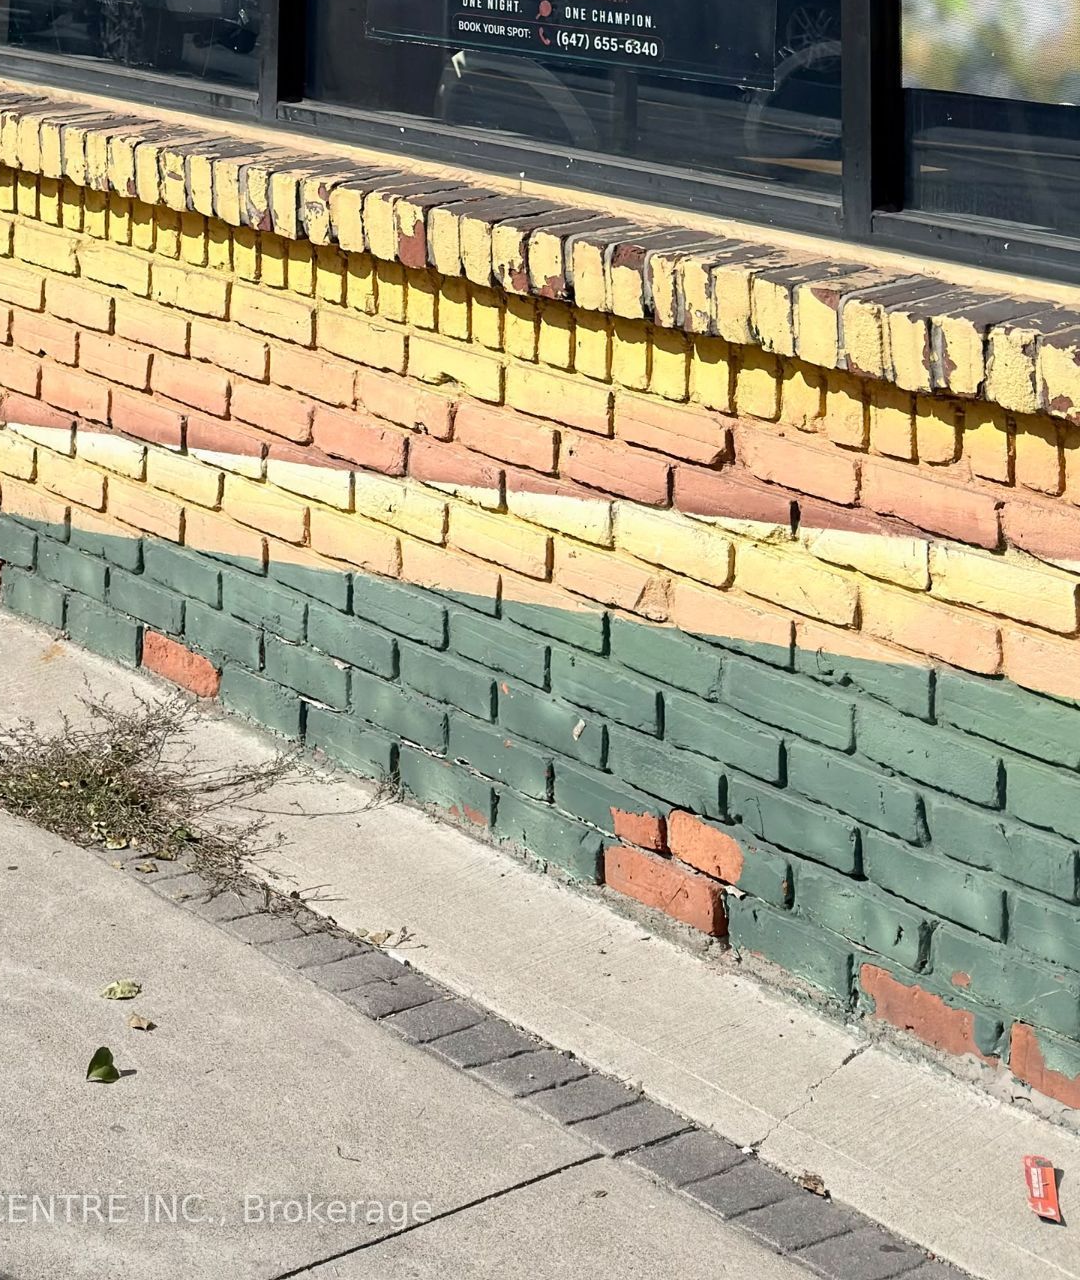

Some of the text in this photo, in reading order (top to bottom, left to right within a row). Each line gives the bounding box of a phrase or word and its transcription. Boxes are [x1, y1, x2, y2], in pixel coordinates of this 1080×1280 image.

[565, 6, 587, 21] ONE
[591, 9, 657, 29] CHAMPION.
[458, 20, 658, 57] BOOK YOUR SPOT: (647) 655-6340
